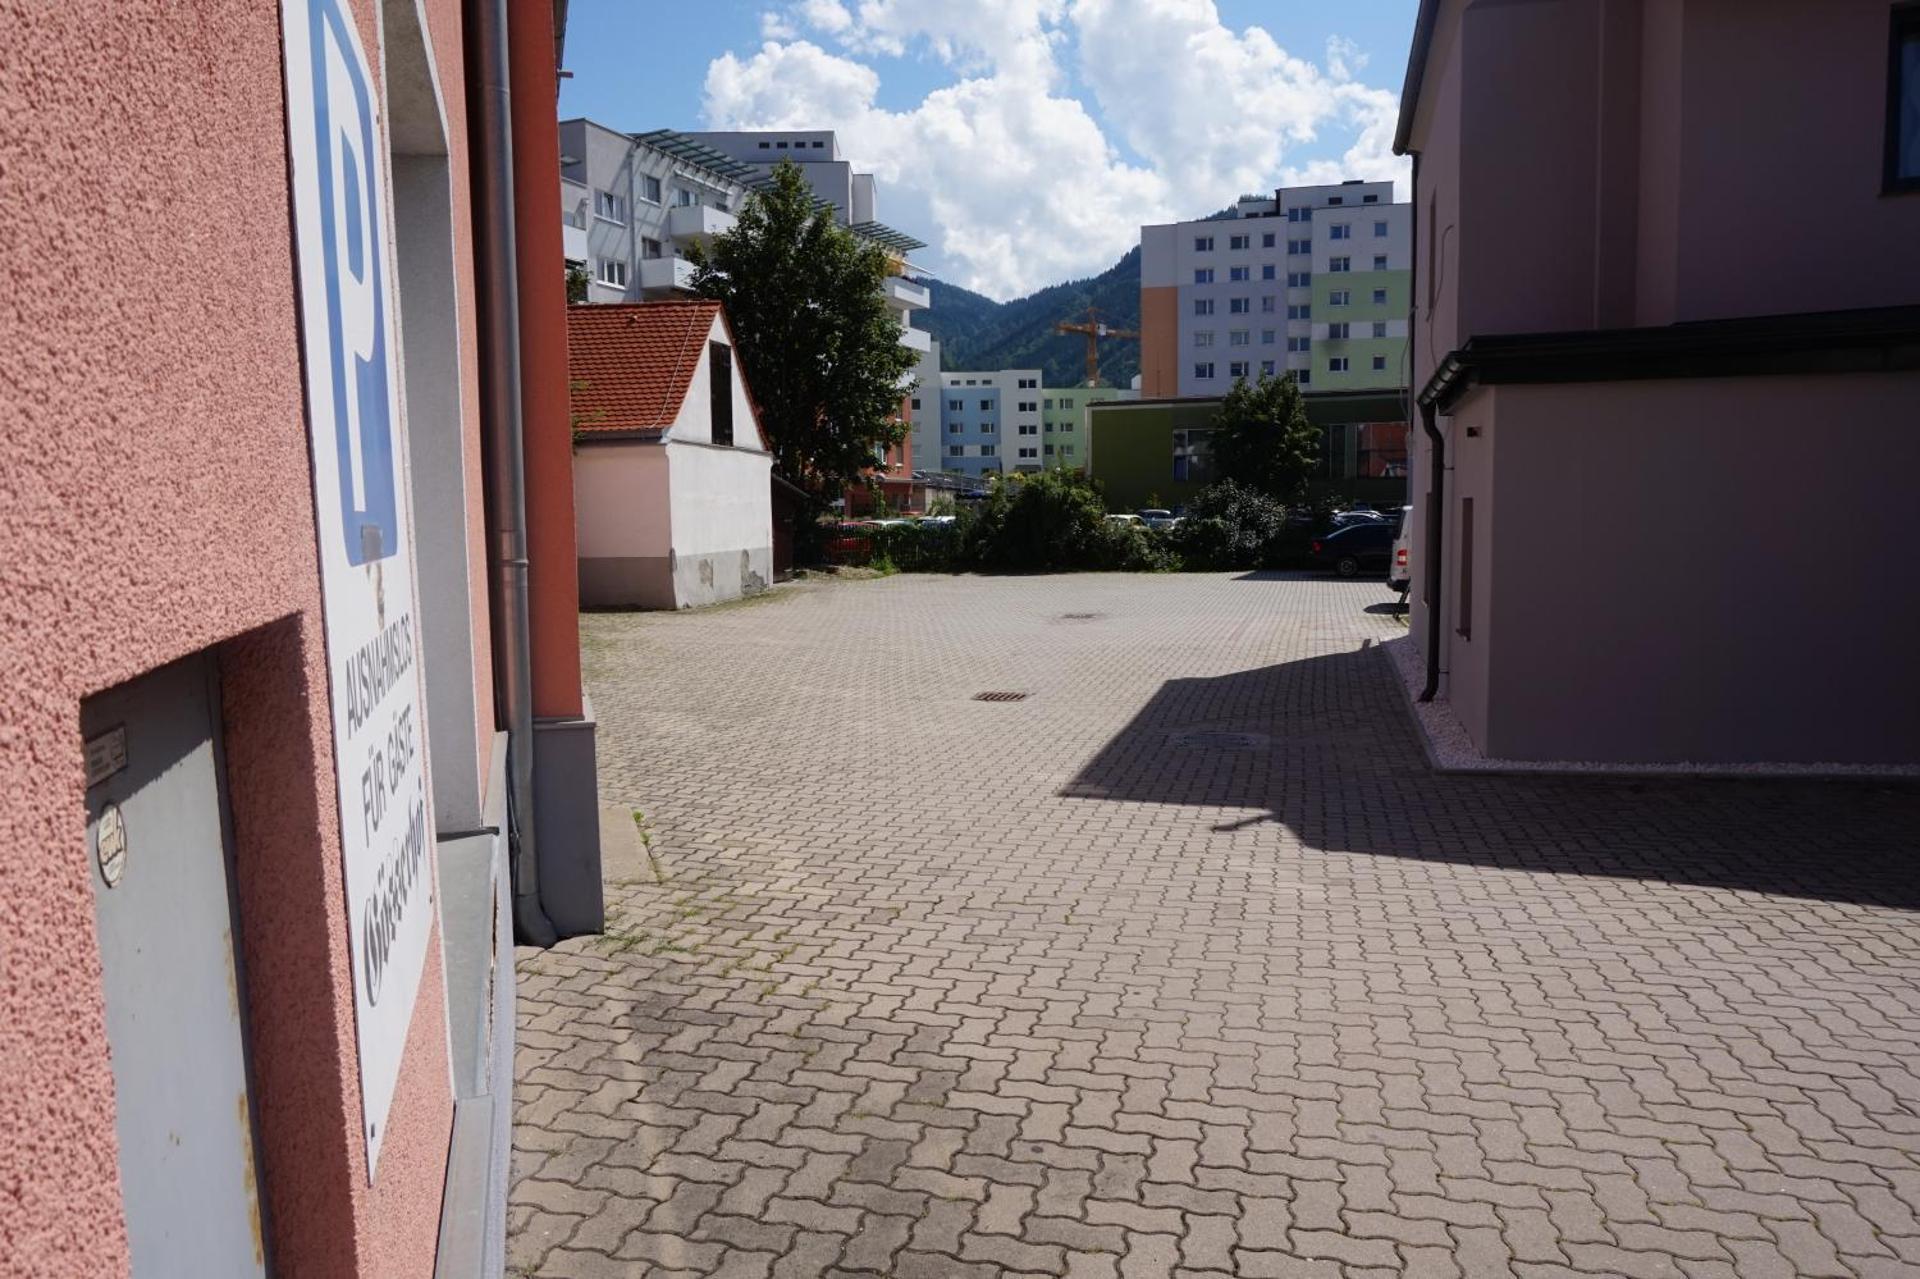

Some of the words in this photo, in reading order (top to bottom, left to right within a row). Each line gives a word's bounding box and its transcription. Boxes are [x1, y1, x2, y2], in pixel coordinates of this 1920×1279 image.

[323, 11, 374, 512] P
[347, 613, 411, 739] AUSNAHMSLOS
[362, 744, 387, 848] FÜR
[387, 703, 414, 796] GÄSTE
